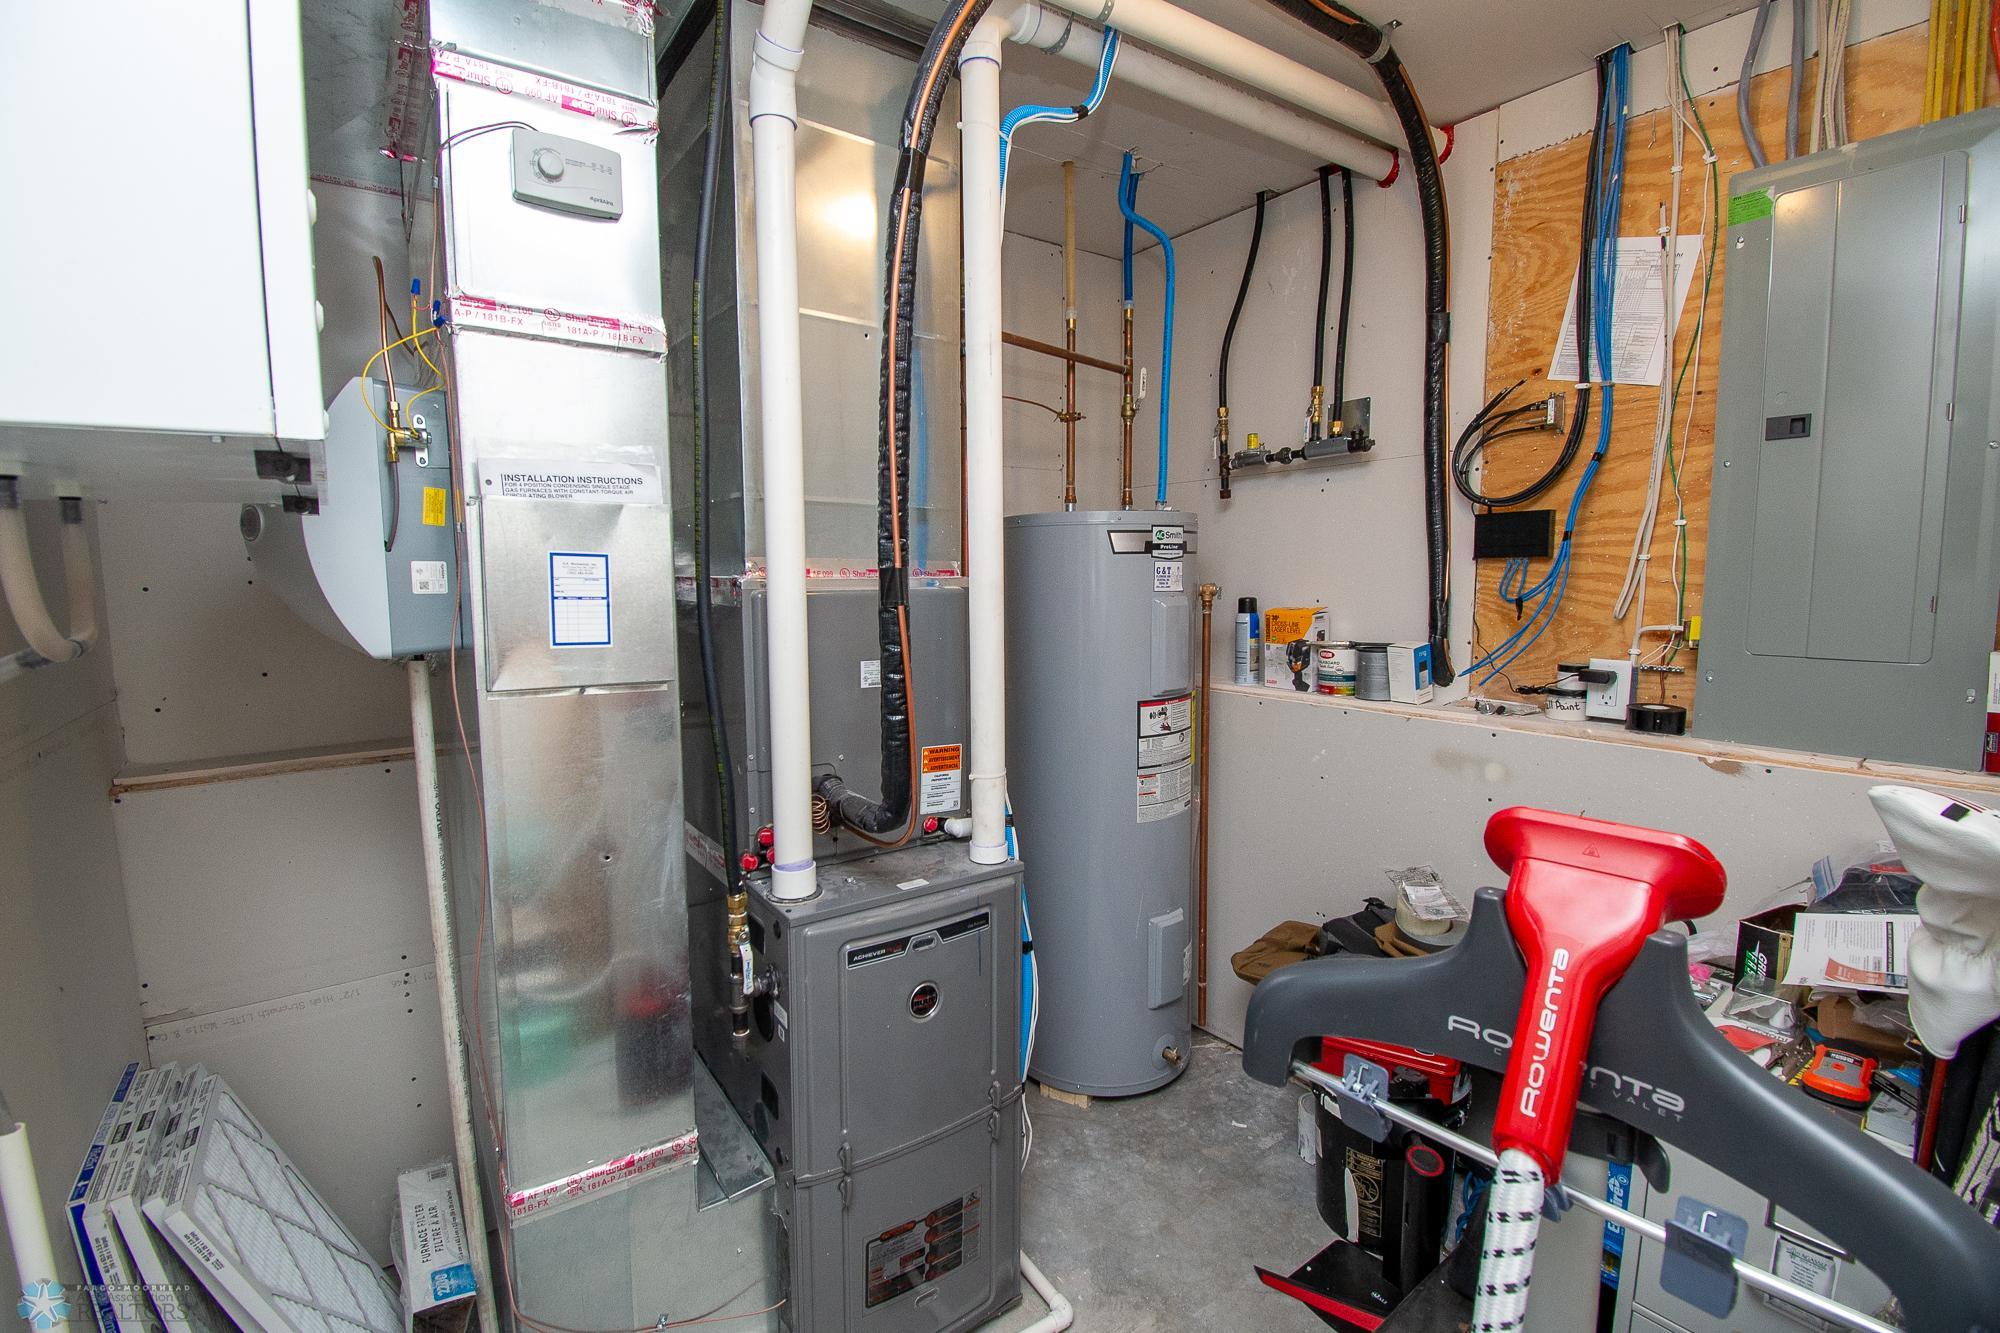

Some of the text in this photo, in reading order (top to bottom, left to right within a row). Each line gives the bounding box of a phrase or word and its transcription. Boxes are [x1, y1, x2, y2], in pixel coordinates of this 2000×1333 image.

[482, 312, 523, 326] 181B-FX
[567, 326, 599, 337] 181A-P
[503, 474, 643, 485] INSTALLATION INSTRUCTIONS
[1555, 699, 1581, 711] Paint
[929, 747, 960, 755] WARNING
[853, 949, 886, 961] ACHIEVER
[1612, 1090, 1684, 1123] VALET
[637, 1154, 648, 1164] AF
[650, 1148, 664, 1160] 100
[513, 1199, 549, 1217] 181B-FX
[587, 1175, 616, 1191] 181A-P
[624, 1162, 657, 1178] 181B-FX
[527, 1190, 540, 1201] AF
[428, 1205, 441, 1218] AIR
[414, 1203, 431, 1264] FURNACE FILTER
[431, 1227, 444, 1253] FILTRE
